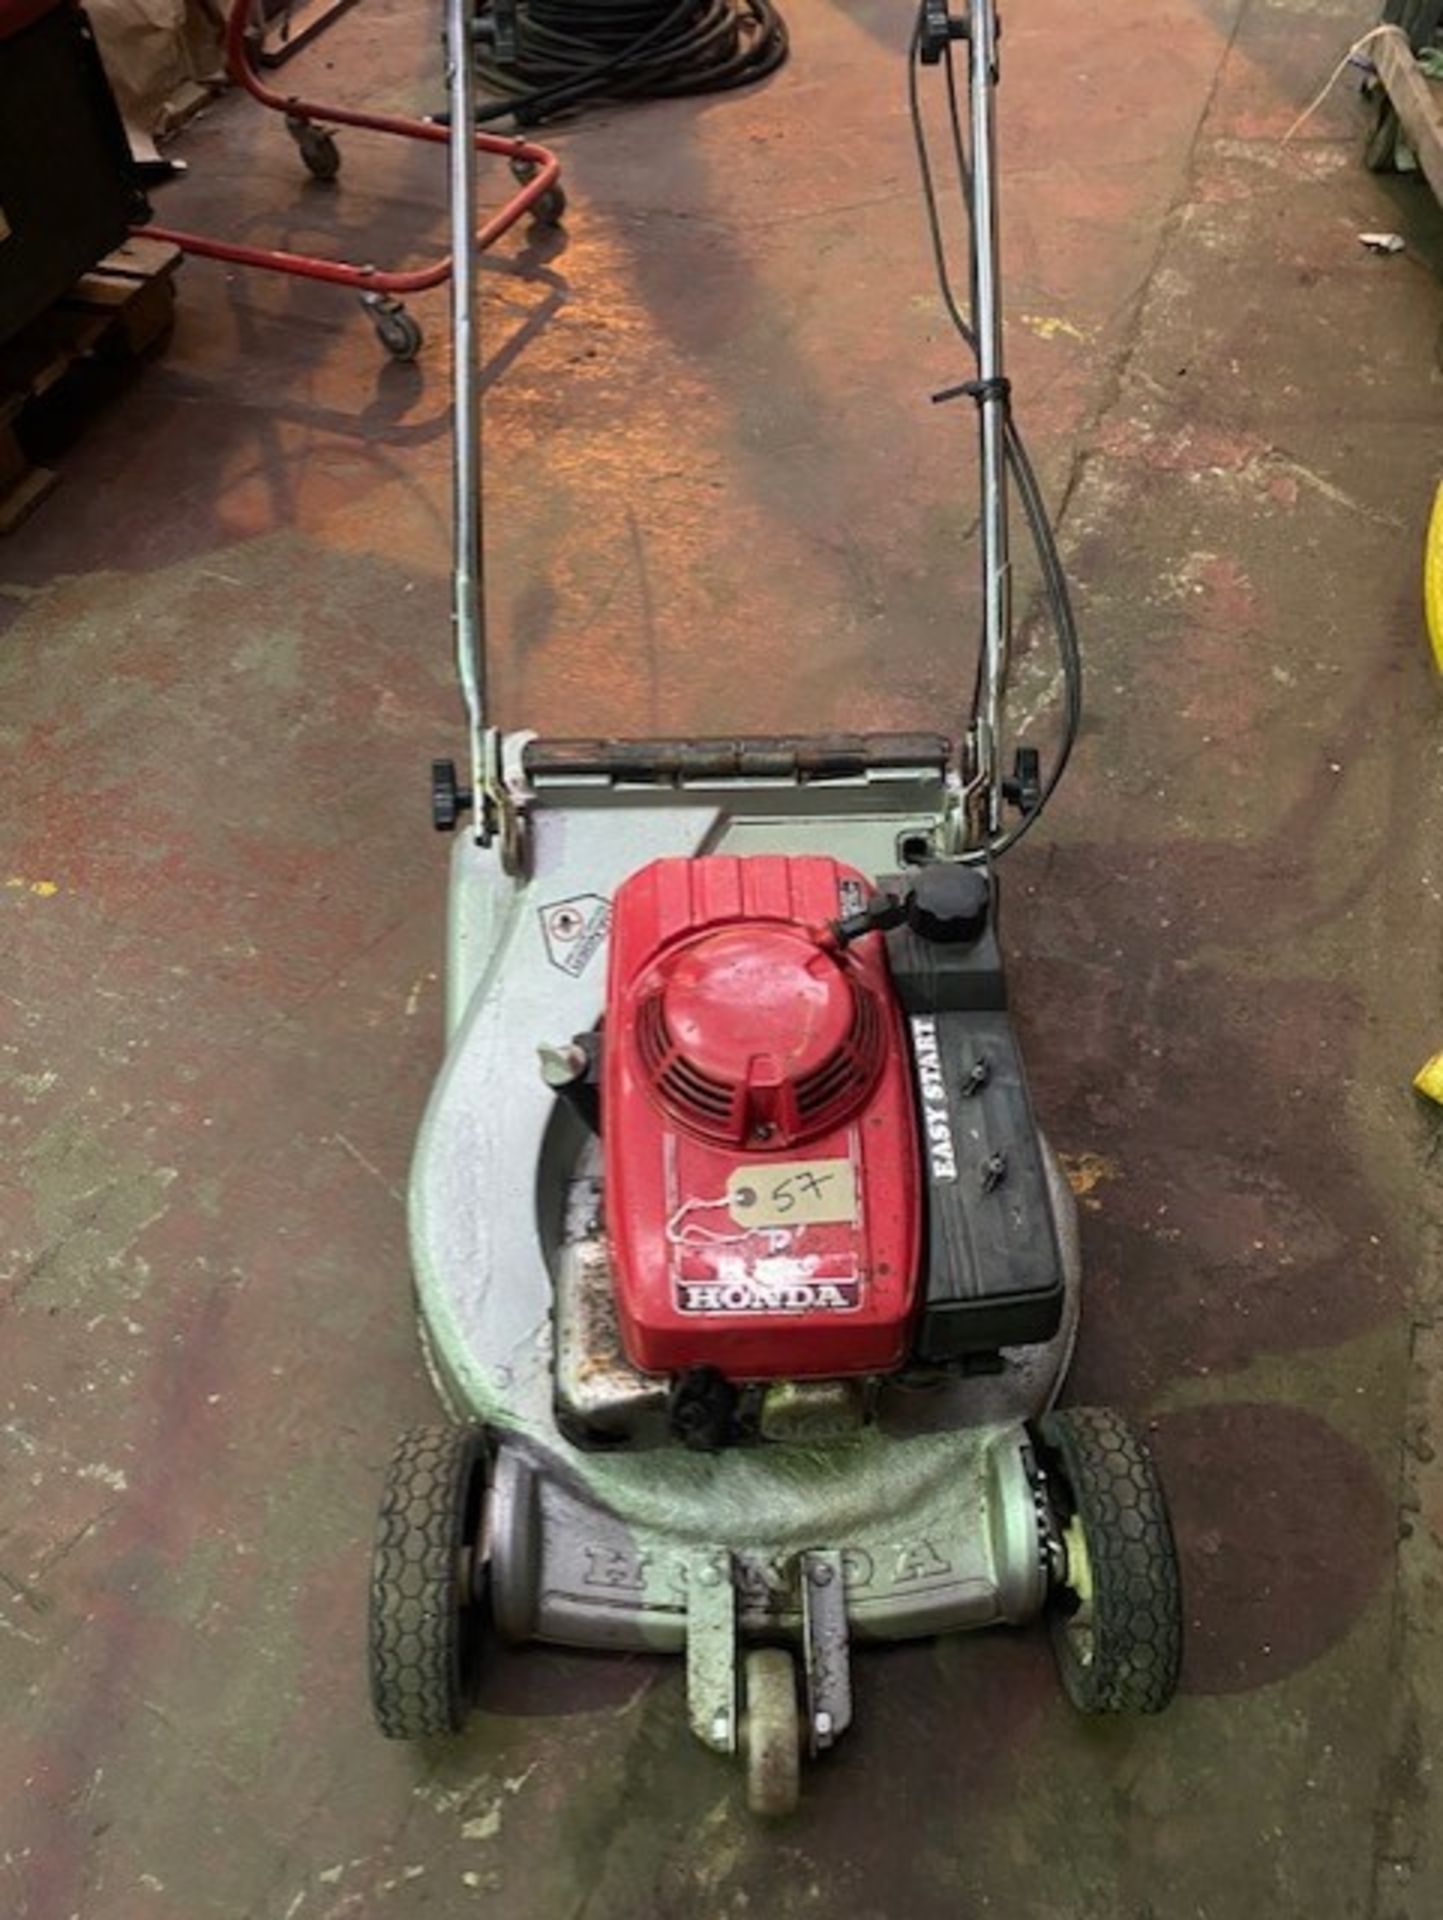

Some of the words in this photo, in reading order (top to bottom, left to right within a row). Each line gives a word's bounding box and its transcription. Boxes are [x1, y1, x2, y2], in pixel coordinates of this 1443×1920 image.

[910, 1015, 946, 1099] START
[925, 1106, 958, 1182] EASY
[772, 1173, 834, 1213] 57
[686, 1285, 850, 1309] HONDA
